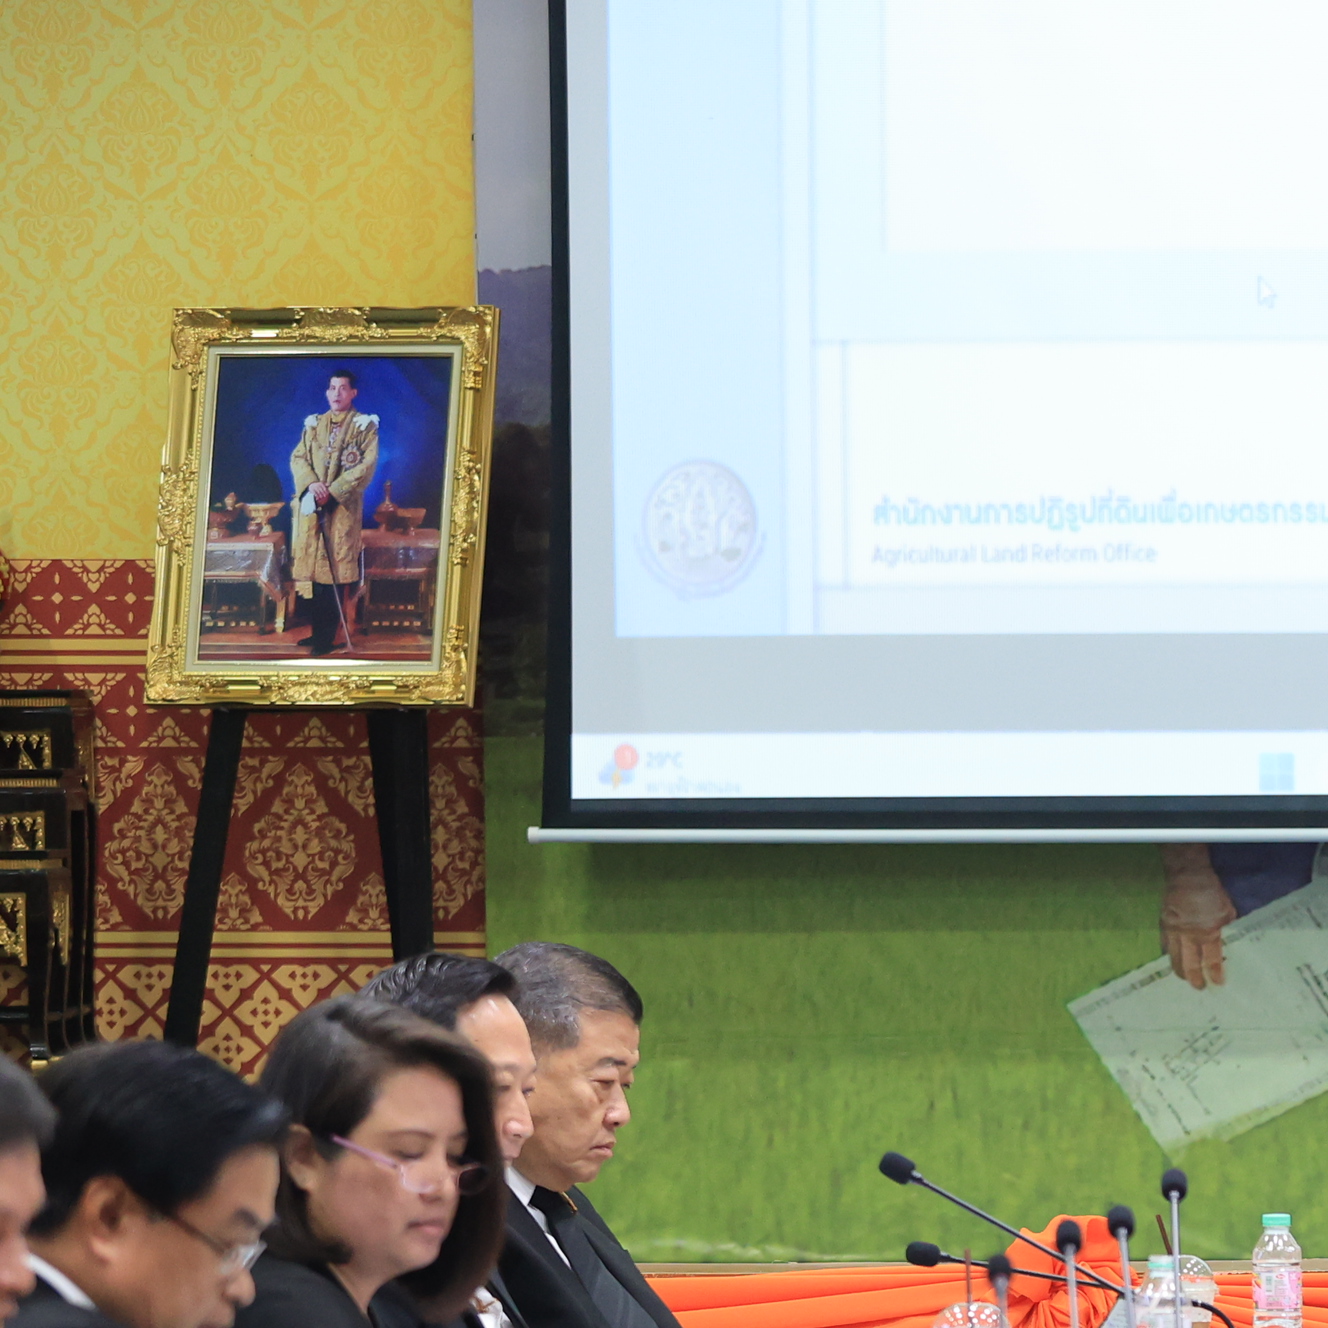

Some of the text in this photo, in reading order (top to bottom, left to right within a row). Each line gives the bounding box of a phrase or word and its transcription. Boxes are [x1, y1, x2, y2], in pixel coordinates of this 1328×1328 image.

[870, 543, 1159, 569] Agricultural Land Reform Office
